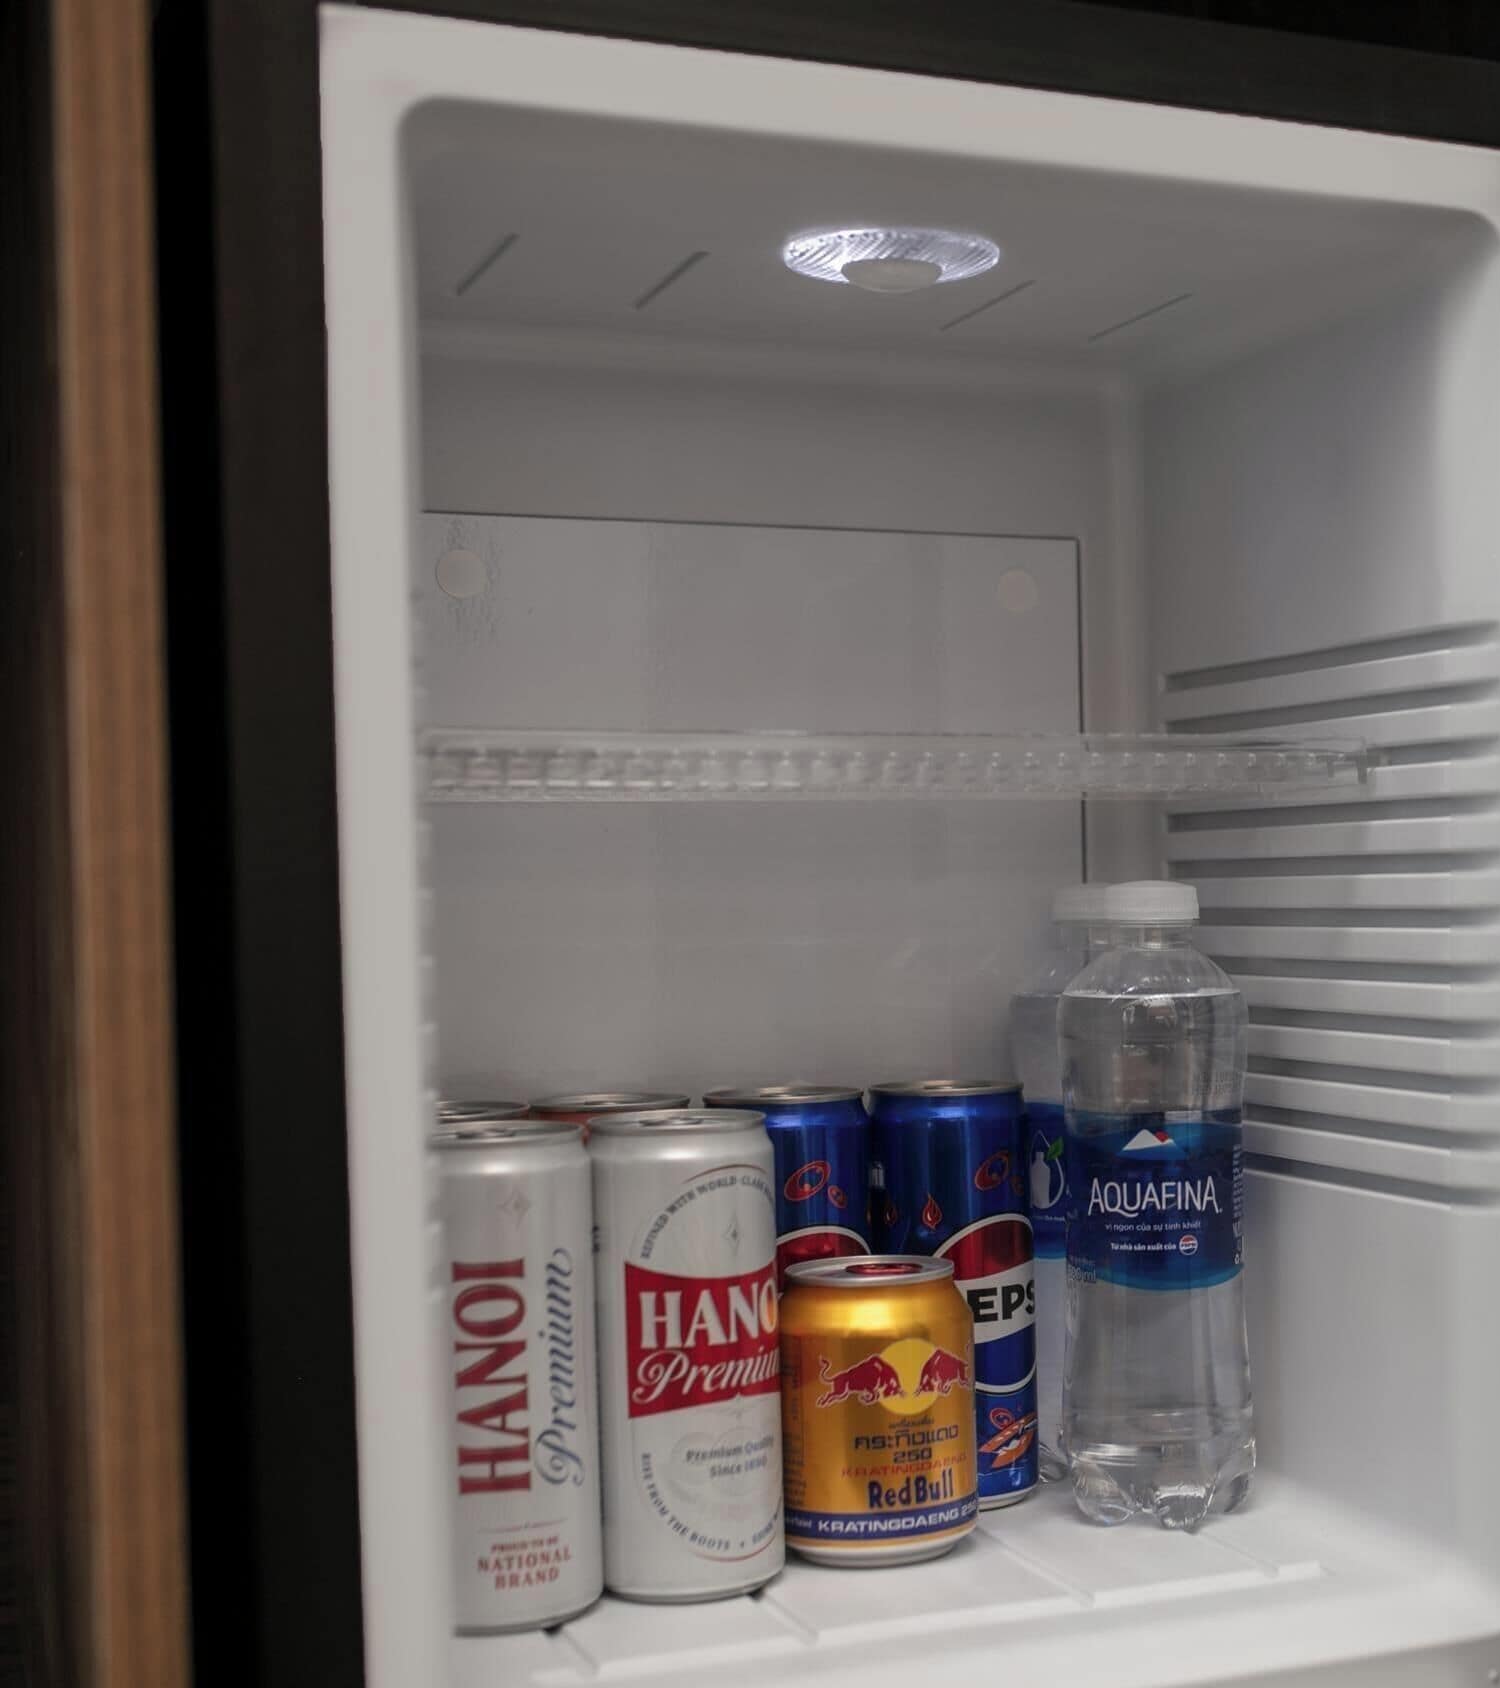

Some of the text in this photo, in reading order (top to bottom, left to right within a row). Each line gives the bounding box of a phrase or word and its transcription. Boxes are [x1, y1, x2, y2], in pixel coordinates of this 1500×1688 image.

[1088, 1174, 1220, 1219] AQUAFINA
[638, 1278, 779, 1350] HANO
[452, 1257, 531, 1495] HANOI
[533, 1247, 586, 1487] Premium
[817, 1507, 959, 1534] KRATINGDAENG
[477, 1544, 571, 1572] NATIONAL
